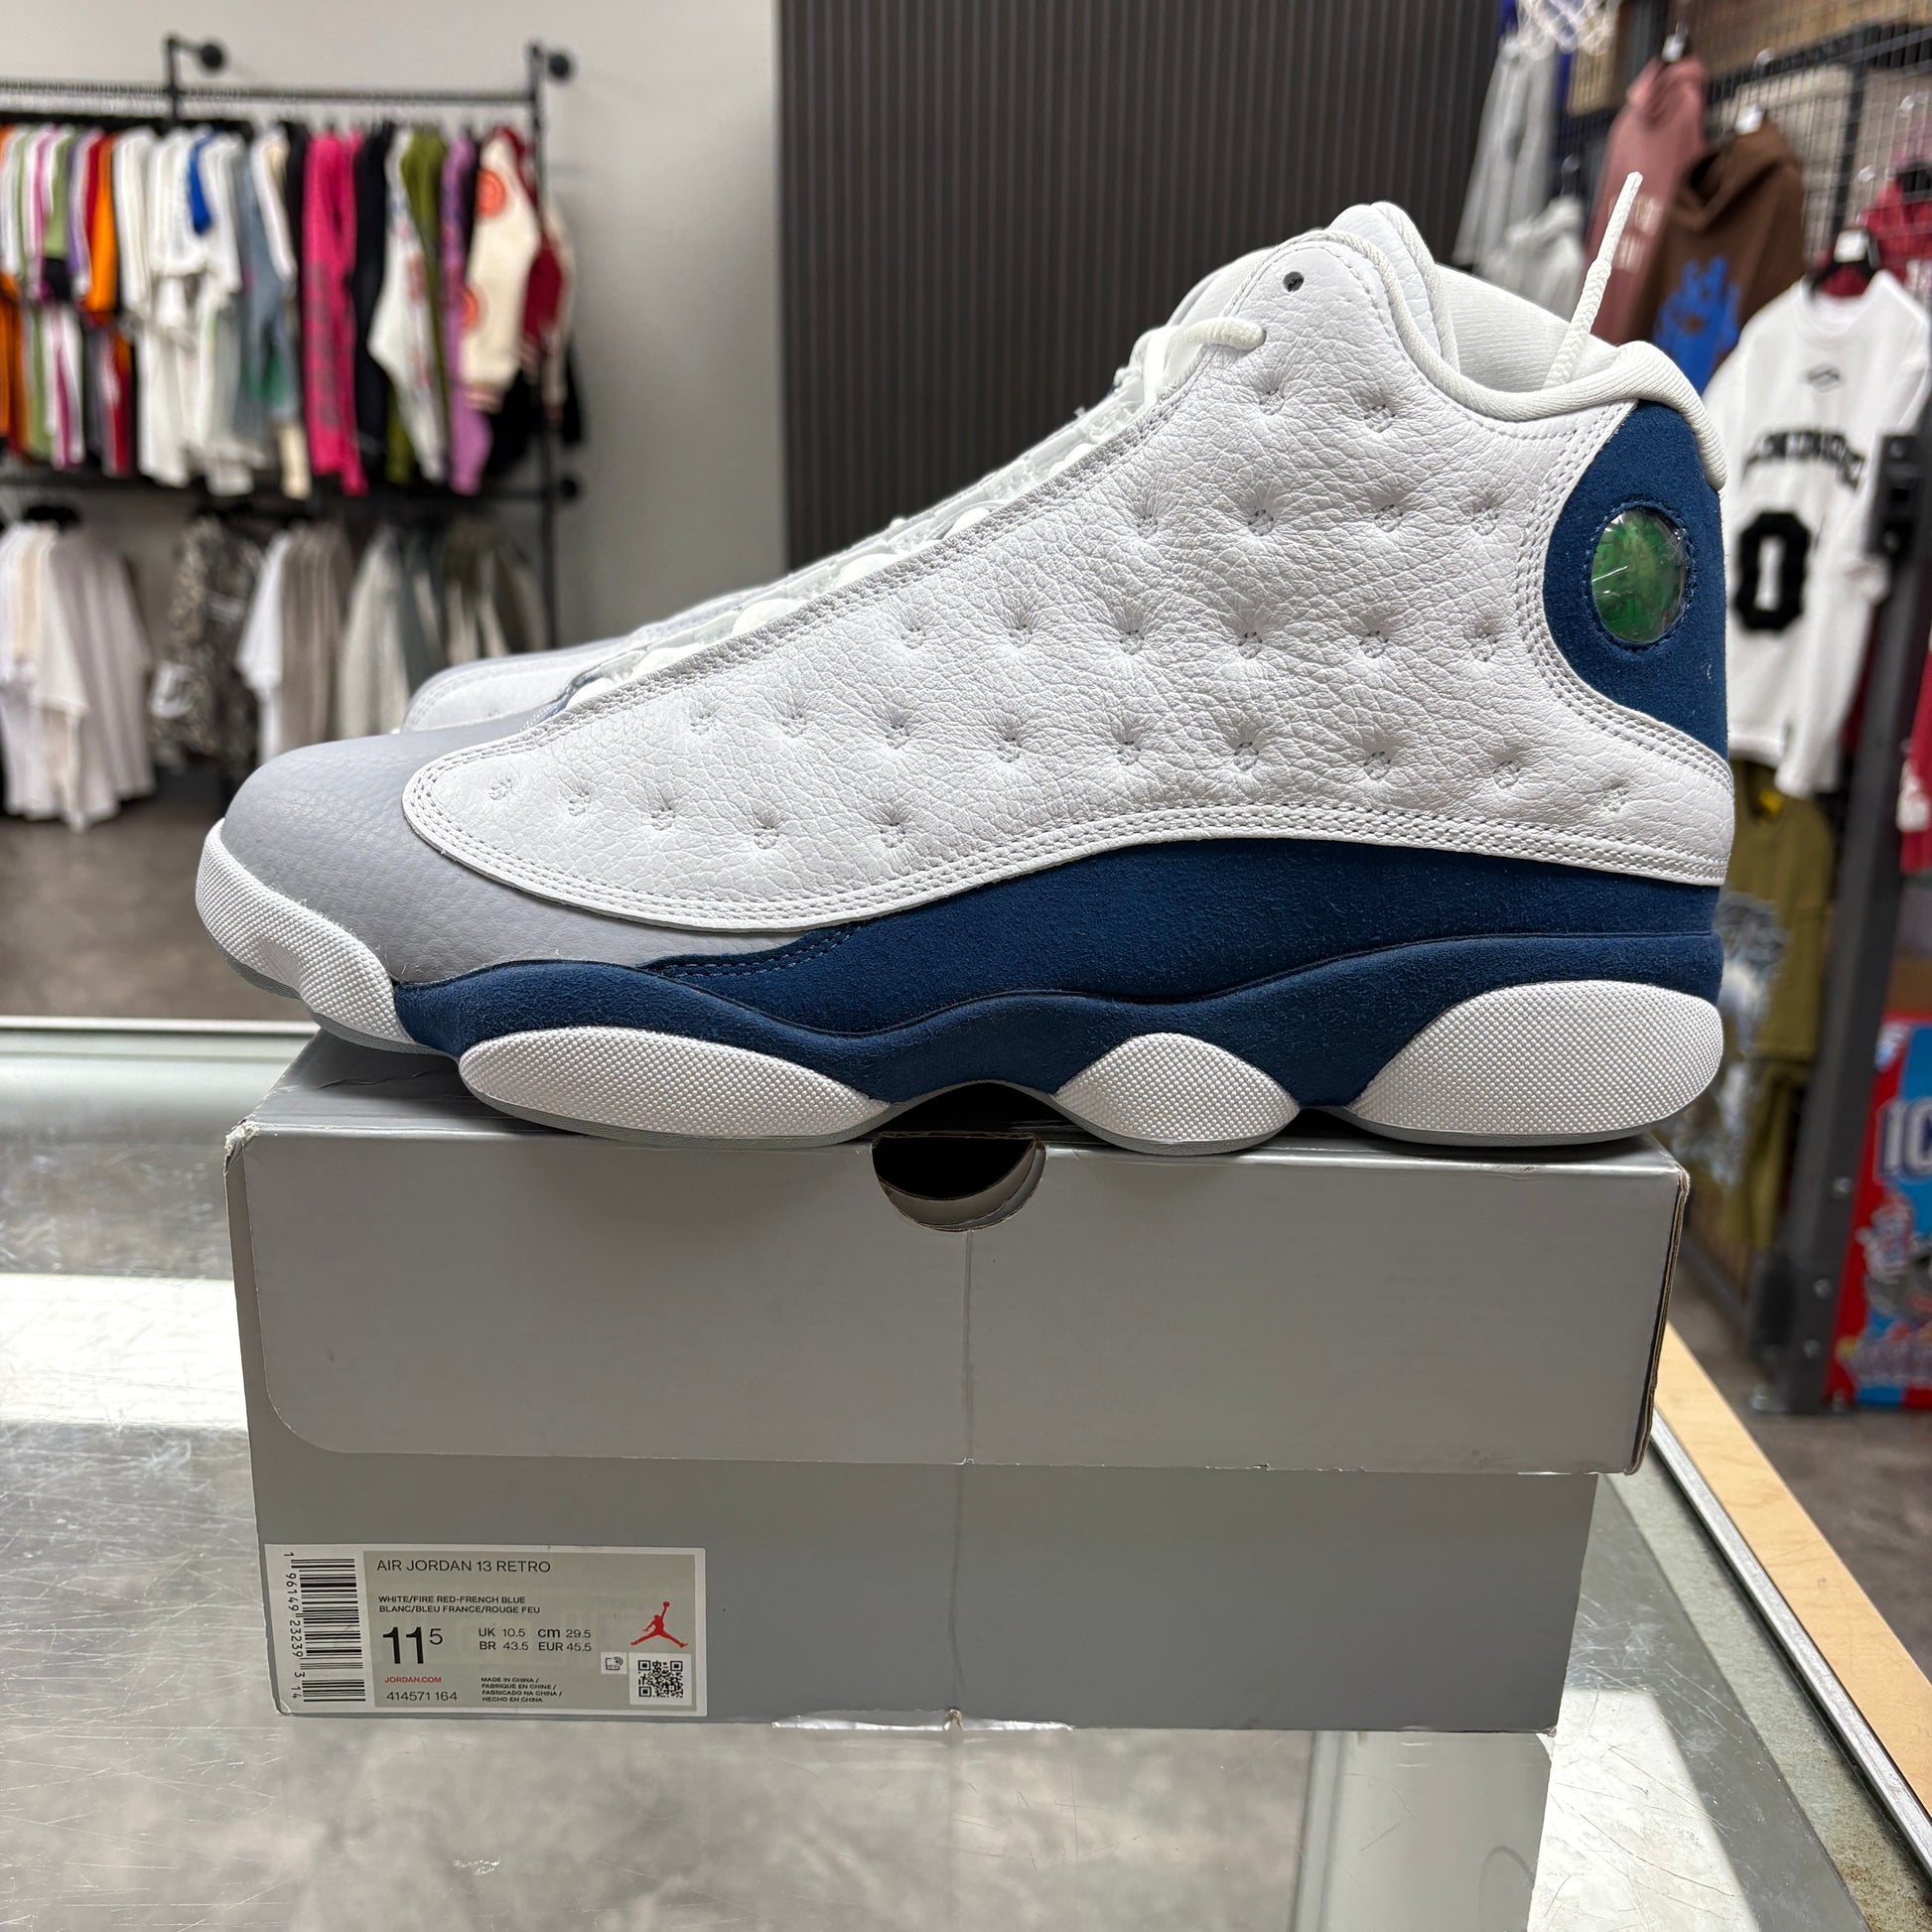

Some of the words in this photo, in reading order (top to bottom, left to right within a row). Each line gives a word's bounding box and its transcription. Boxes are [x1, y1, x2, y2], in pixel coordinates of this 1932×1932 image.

[376, 1559, 402, 1572] AIR
[406, 1559, 473, 1572] JORDAN
[476, 1560, 492, 1573] 13
[496, 1560, 551, 1573] RETRO
[286, 1573, 300, 1611] 96149
[378, 1594, 435, 1603] WHITE/FIRE
[501, 1595, 526, 1604] BLUE
[379, 1604, 441, 1613] BLANC/BLEU
[442, 1605, 519, 1614] FRANCE/ROUGE
[521, 1605, 541, 1614] FEU
[289, 1619, 304, 1658] 23239
[479, 1627, 496, 1637] UK
[502, 1627, 526, 1638] 10.5
[537, 1628, 561, 1638] cm
[565, 1628, 592, 1639] 29.5
[479, 1640, 496, 1651] BR
[502, 1641, 529, 1651] 43.5
[538, 1641, 564, 1652] EUR
[566, 1642, 593, 1652] 45.5
[385, 1691, 431, 1701] 414571
[434, 1691, 459, 1701] 164
